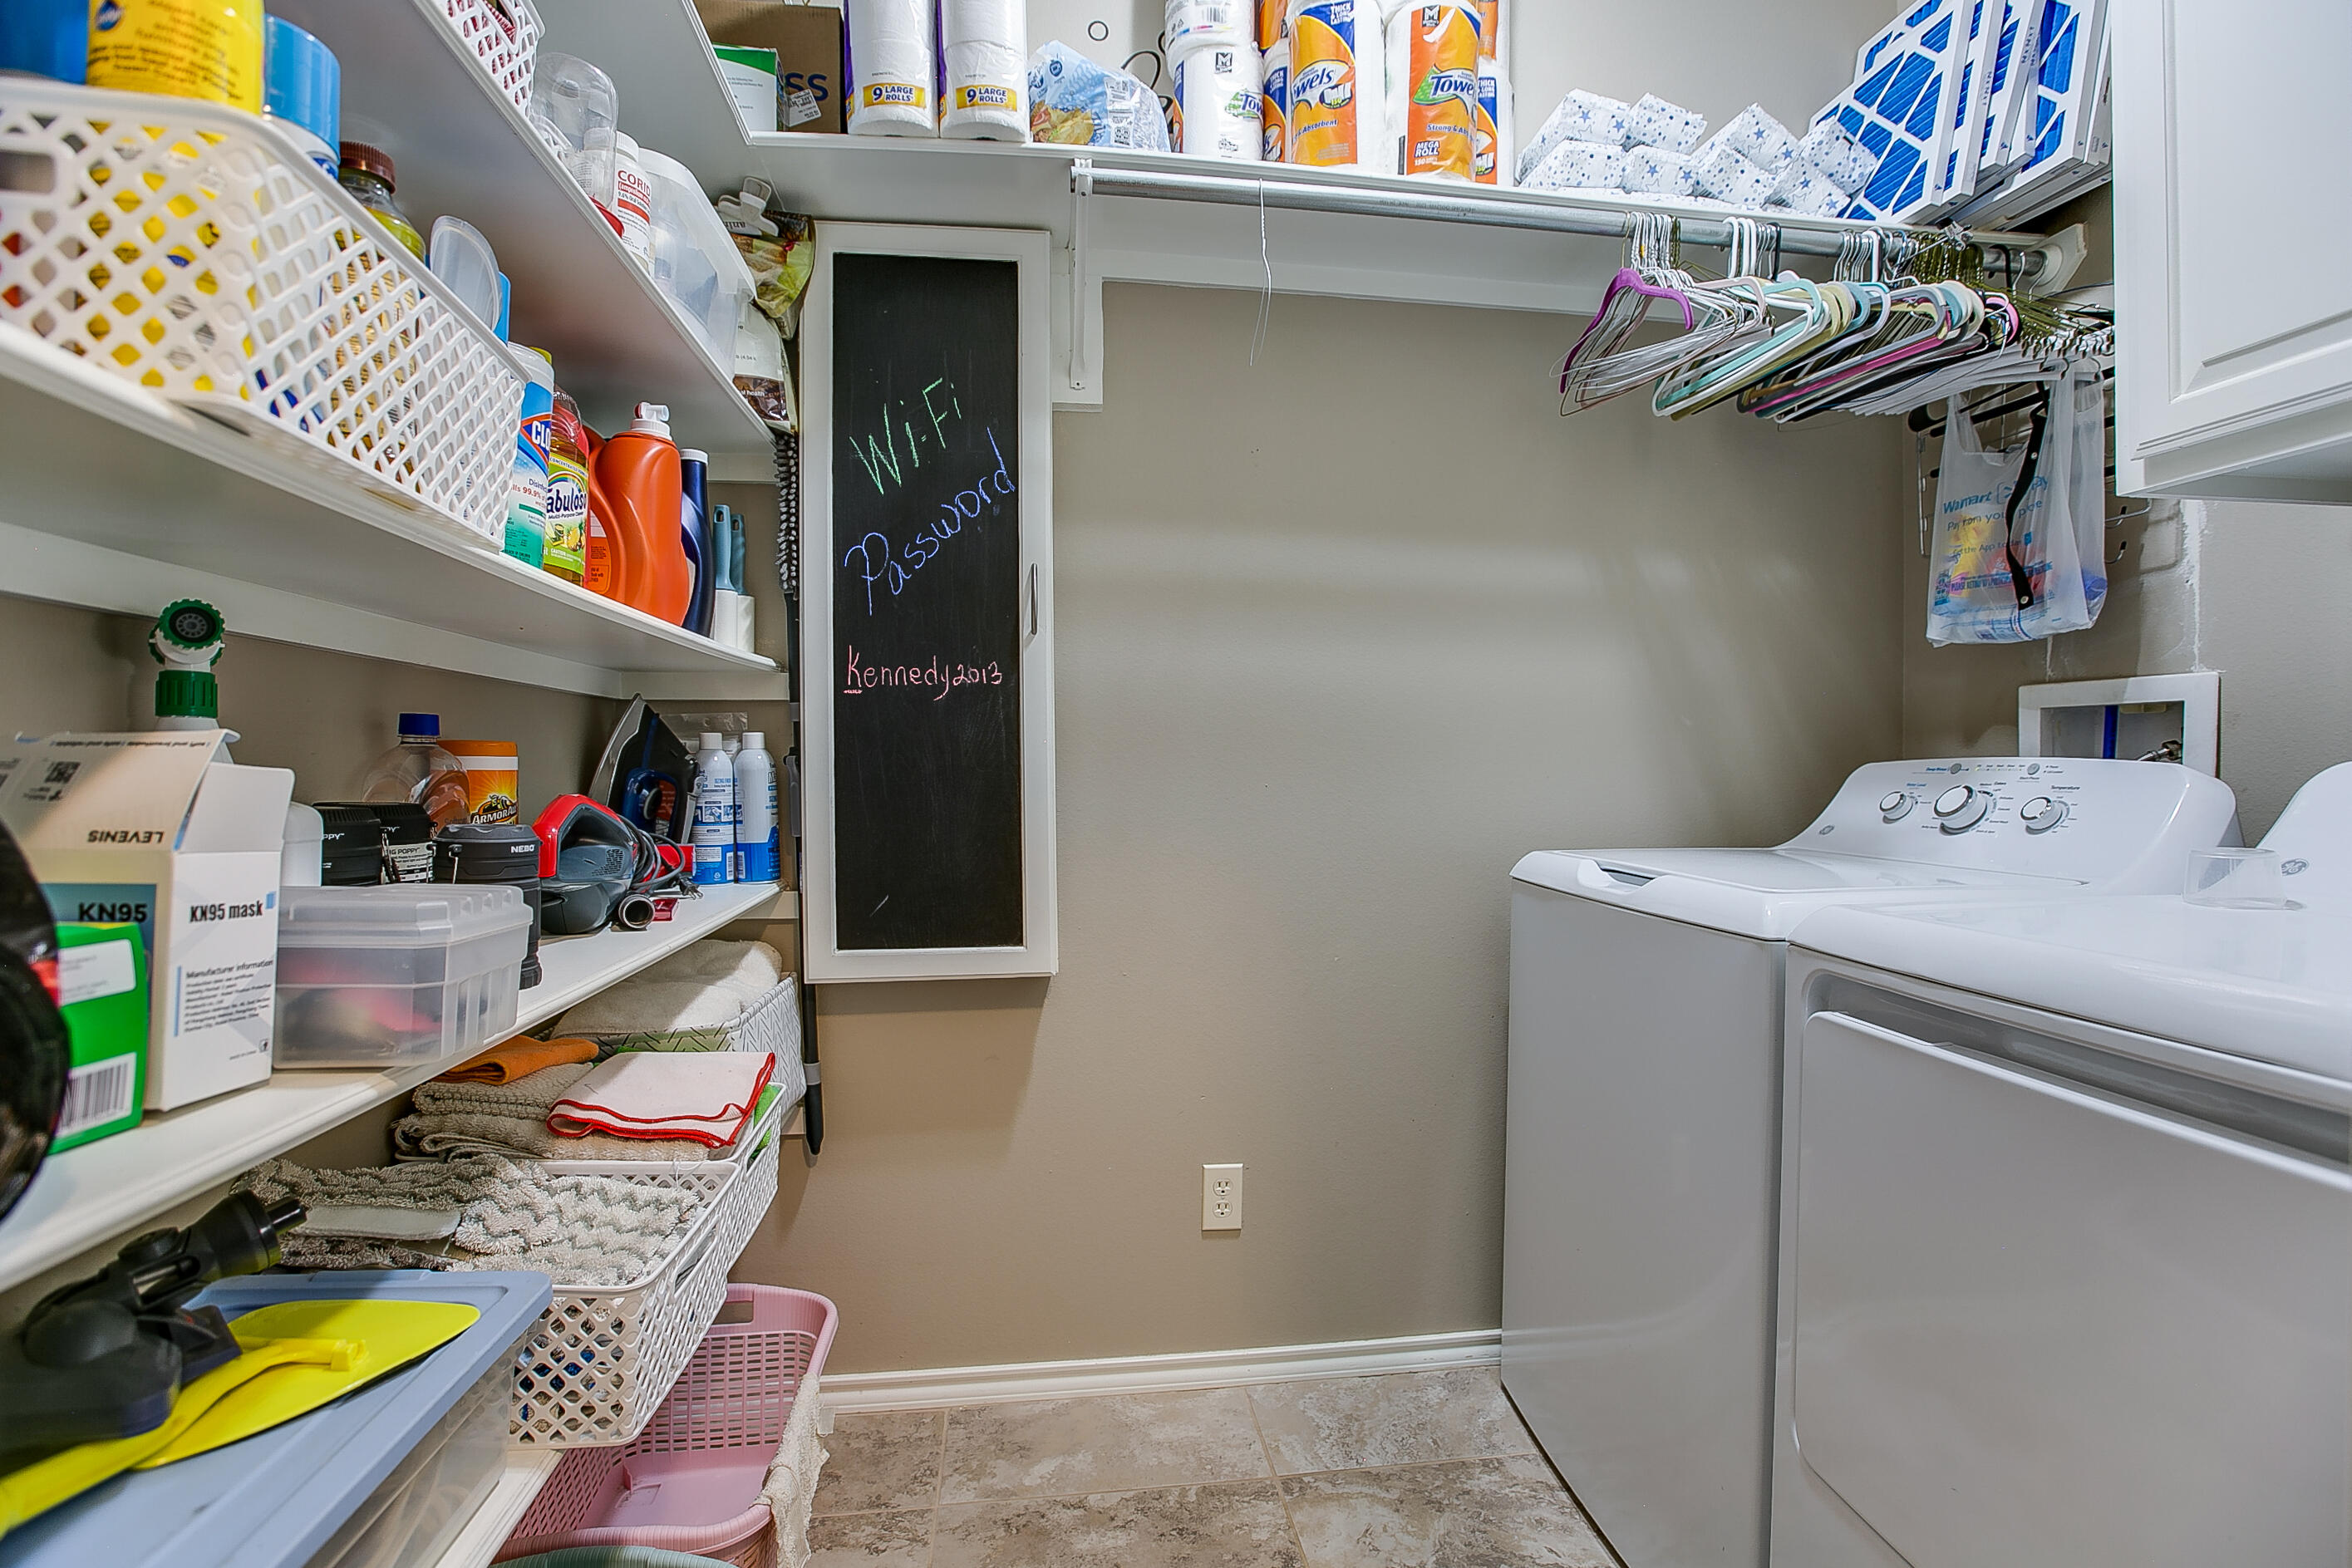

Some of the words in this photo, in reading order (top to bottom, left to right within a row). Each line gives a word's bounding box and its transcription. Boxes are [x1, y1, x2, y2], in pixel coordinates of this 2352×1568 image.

[1293, 67, 1335, 98] wels
[873, 86, 883, 101] 9
[885, 86, 913, 95] LARGE
[967, 88, 977, 103] 9
[978, 87, 1006, 97] LARGE
[1302, 120, 1337, 133] Absorbent
[1415, 147, 1439, 157] ROLL
[618, 170, 650, 196] CORID
[849, 377, 962, 495] Wi-Fi
[844, 426, 1016, 616] Password
[1979, 544, 1995, 553] App
[846, 644, 1002, 700] Kennedy2013
[87, 830, 165, 843] LEVENIS
[511, 845, 534, 853] NEBO
[78, 902, 148, 922] KN95
[229, 900, 264, 920] mask
[236, 959, 274, 972] information
